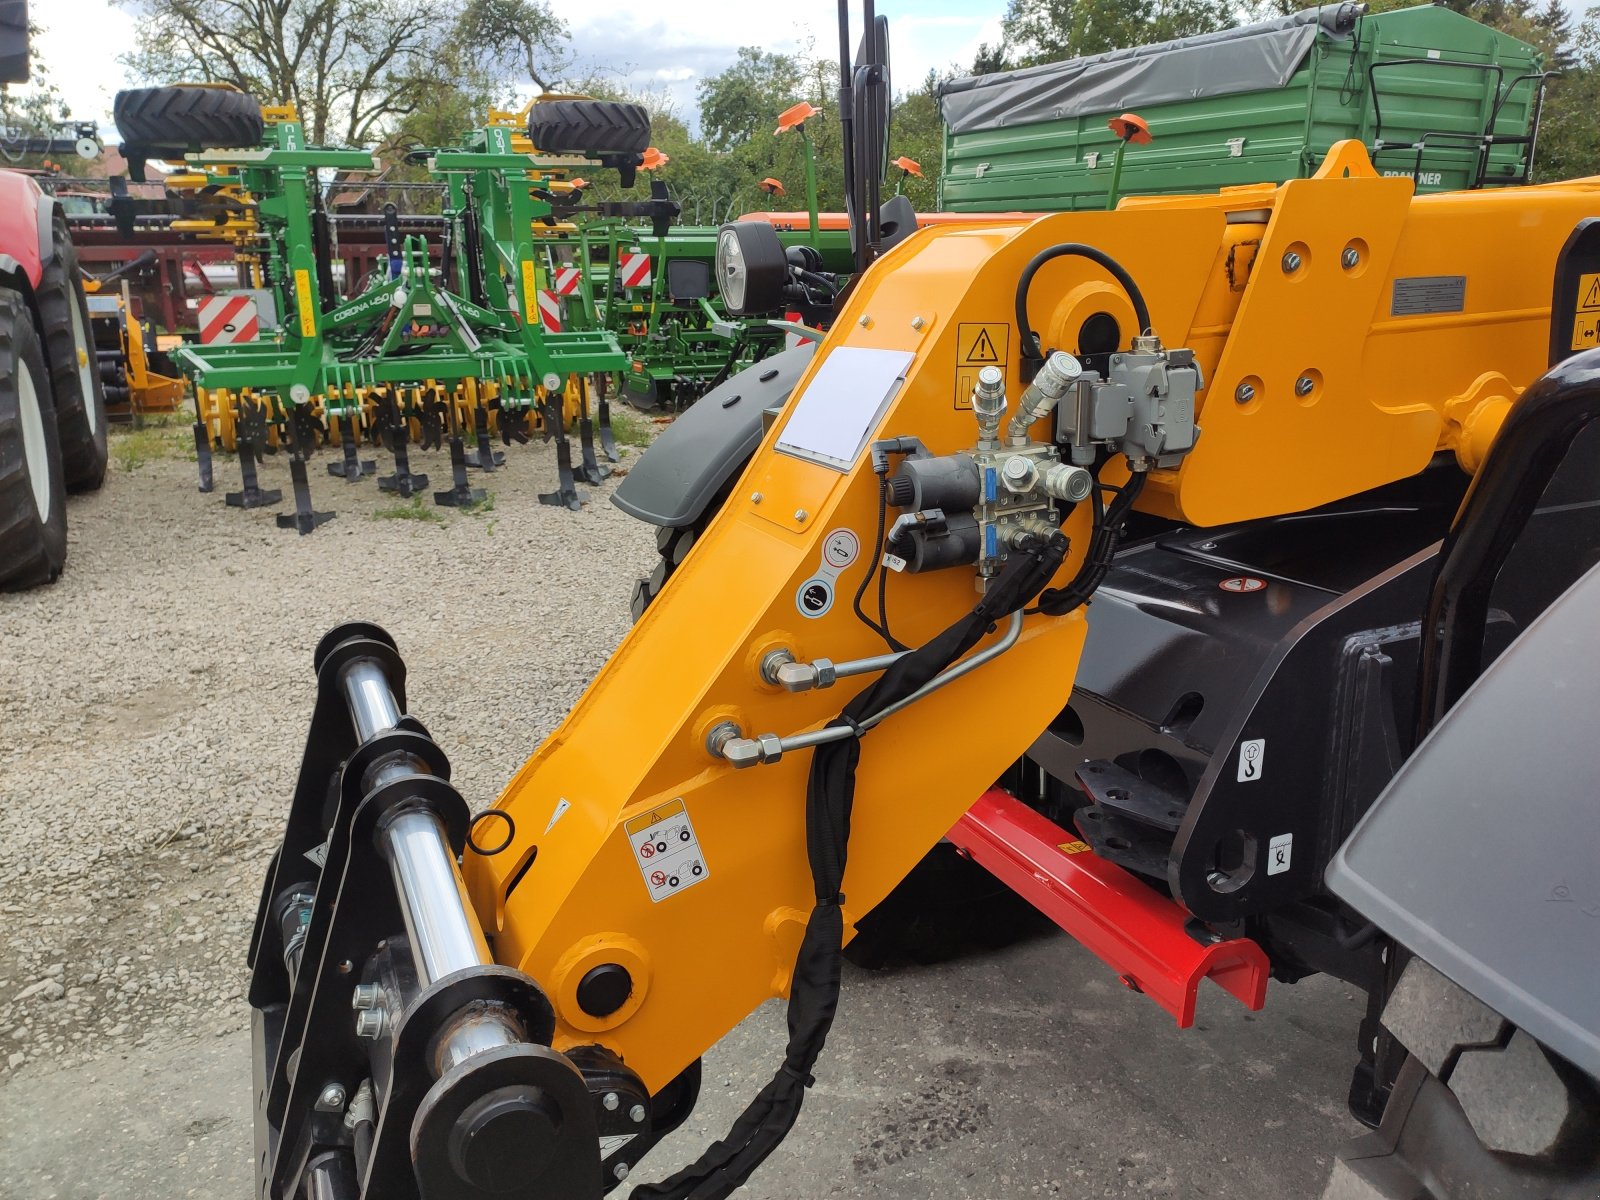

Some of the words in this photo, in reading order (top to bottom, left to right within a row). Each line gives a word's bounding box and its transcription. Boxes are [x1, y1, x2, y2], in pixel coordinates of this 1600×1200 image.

[334, 302, 369, 322] CORONA
[369, 293, 390, 306] 450
[463, 305, 480, 318] 450
